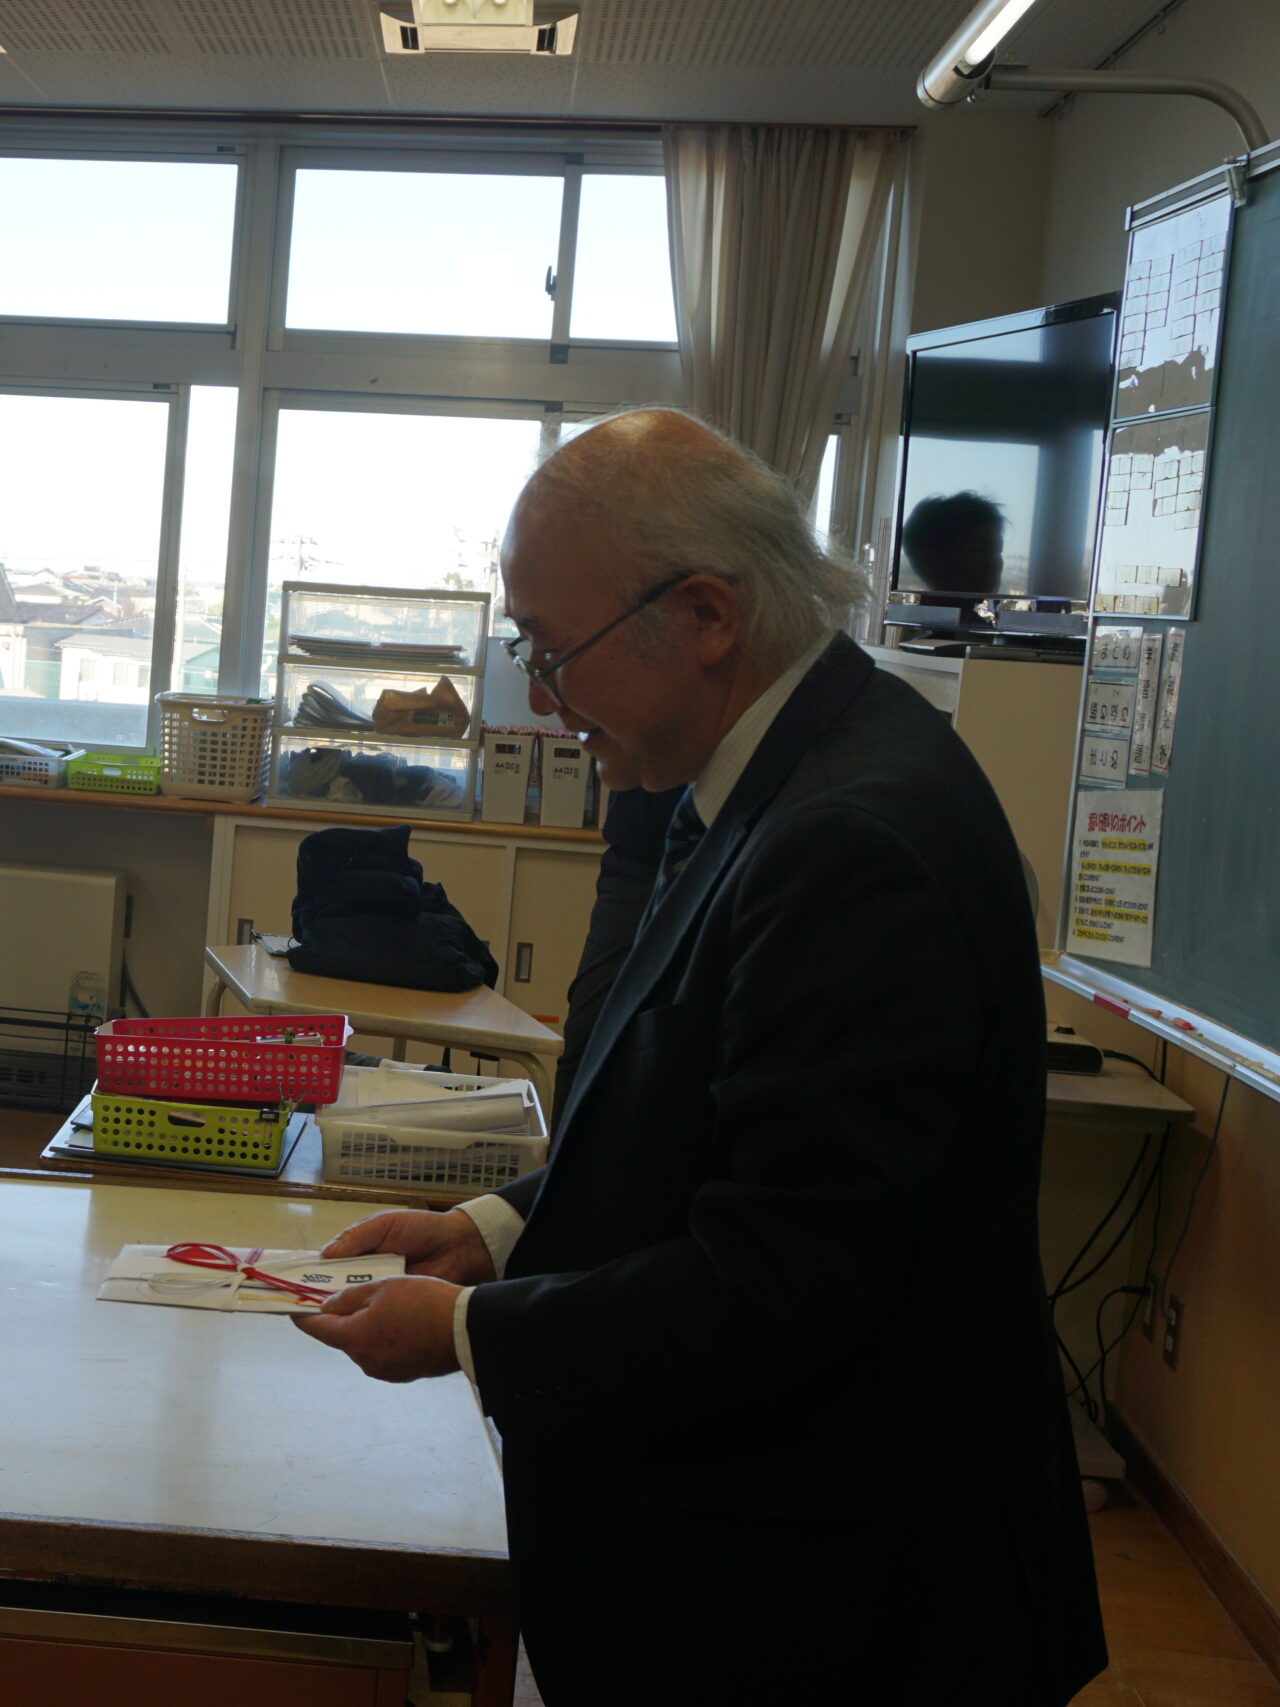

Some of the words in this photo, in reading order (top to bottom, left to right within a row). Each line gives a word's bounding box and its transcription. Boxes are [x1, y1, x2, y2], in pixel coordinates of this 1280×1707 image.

[1088, 811, 1147, 833] のポイント
